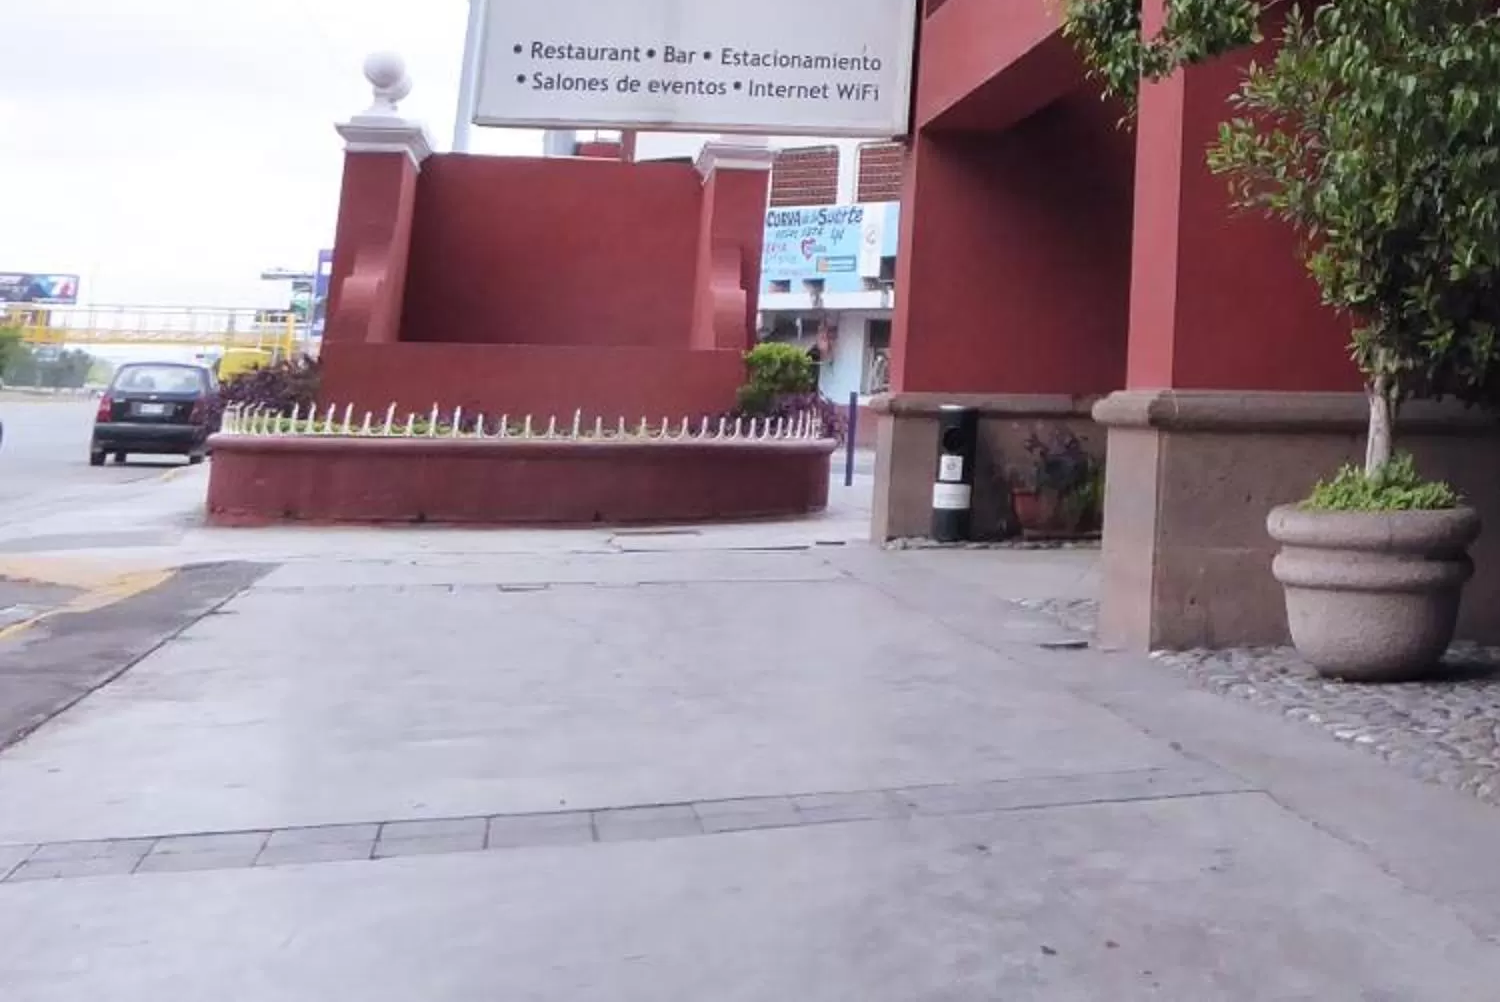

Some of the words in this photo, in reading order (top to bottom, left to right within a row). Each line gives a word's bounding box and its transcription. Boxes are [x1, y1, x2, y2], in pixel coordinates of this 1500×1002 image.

[531, 41, 641, 62] Restaurant
[663, 45, 696, 64] Bar
[721, 47, 882, 71] Estacionamiento
[532, 72, 609, 91] Salones
[616, 75, 641, 93] de
[647, 78, 728, 95] eventos
[748, 79, 829, 99] Internet
[836, 82, 880, 101] WiFi
